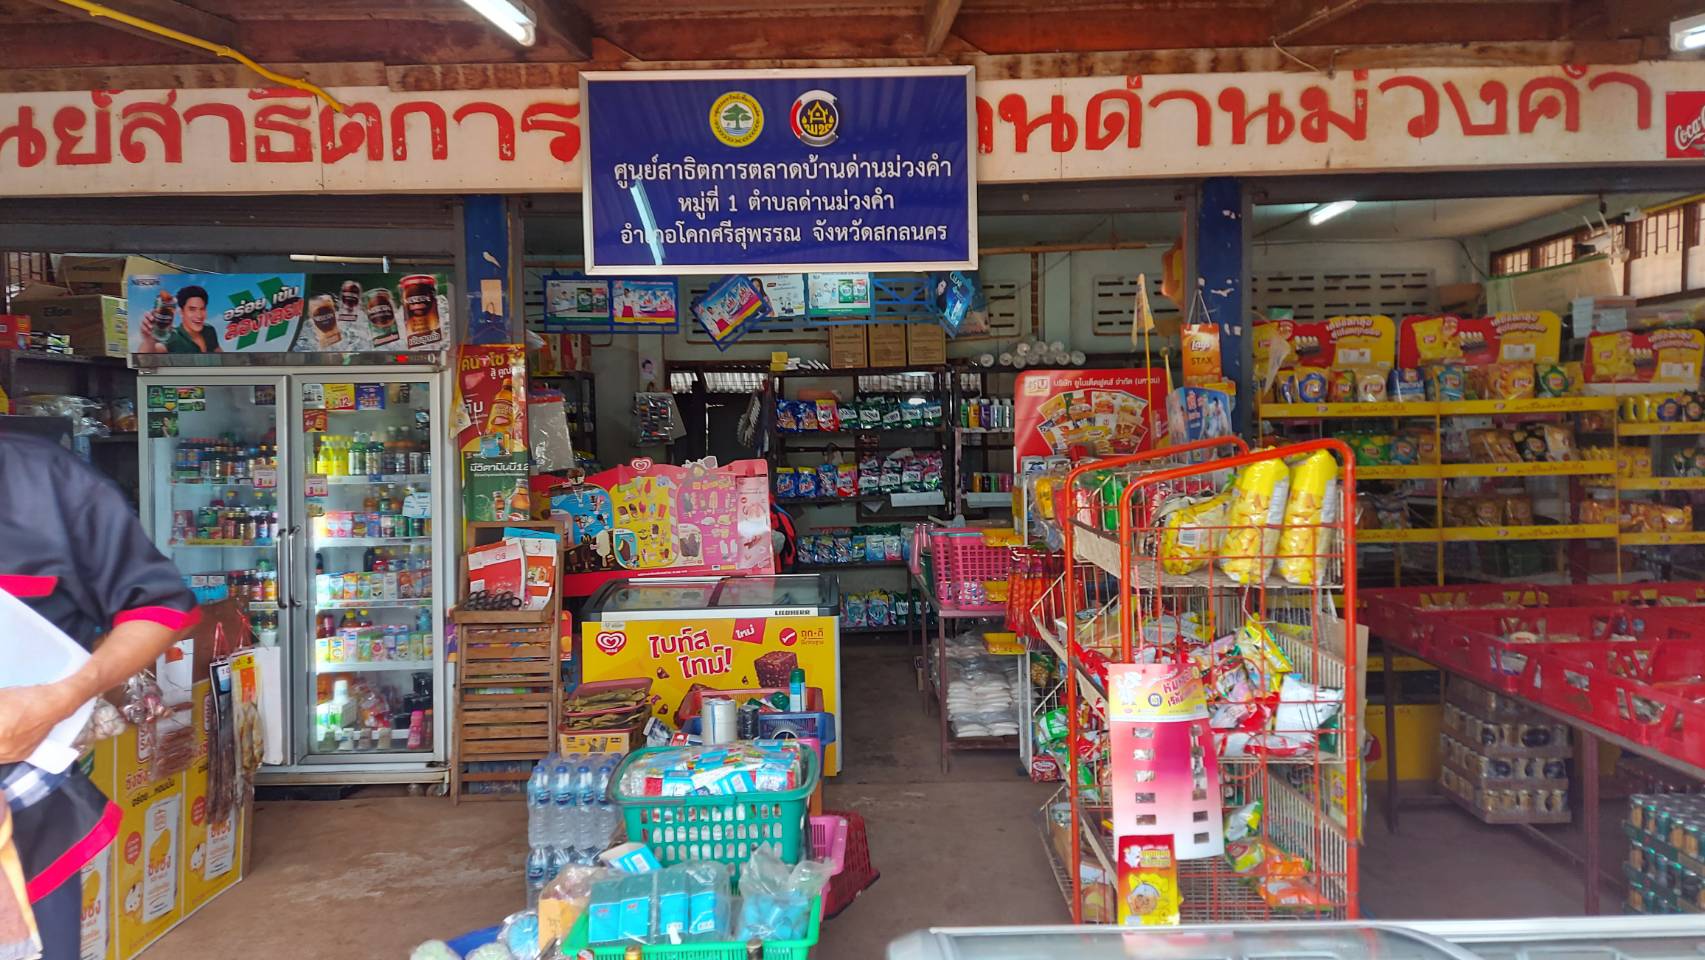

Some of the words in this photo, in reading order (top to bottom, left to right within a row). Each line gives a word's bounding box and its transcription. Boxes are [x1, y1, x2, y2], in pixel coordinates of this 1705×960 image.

[613, 154, 953, 188] ศูนย์สาธิตการตลาดบ้านด่านม่วงคำ
[677, 186, 720, 220] หมู่ที่
[728, 194, 739, 212] 1
[748, 188, 895, 213] ตำบลด่านม่วงคำ
[812, 218, 948, 243] จังหวัดสกลนคร
[223, 297, 267, 322] อร่อย
[1191, 356, 1213, 366] STAX
[1134, 376, 1161, 387] (มหชน)
[648, 627, 710, 659] ไบท์ส
[735, 624, 755, 639] ใหม่
[678, 645, 733, 679] ไทม์!
